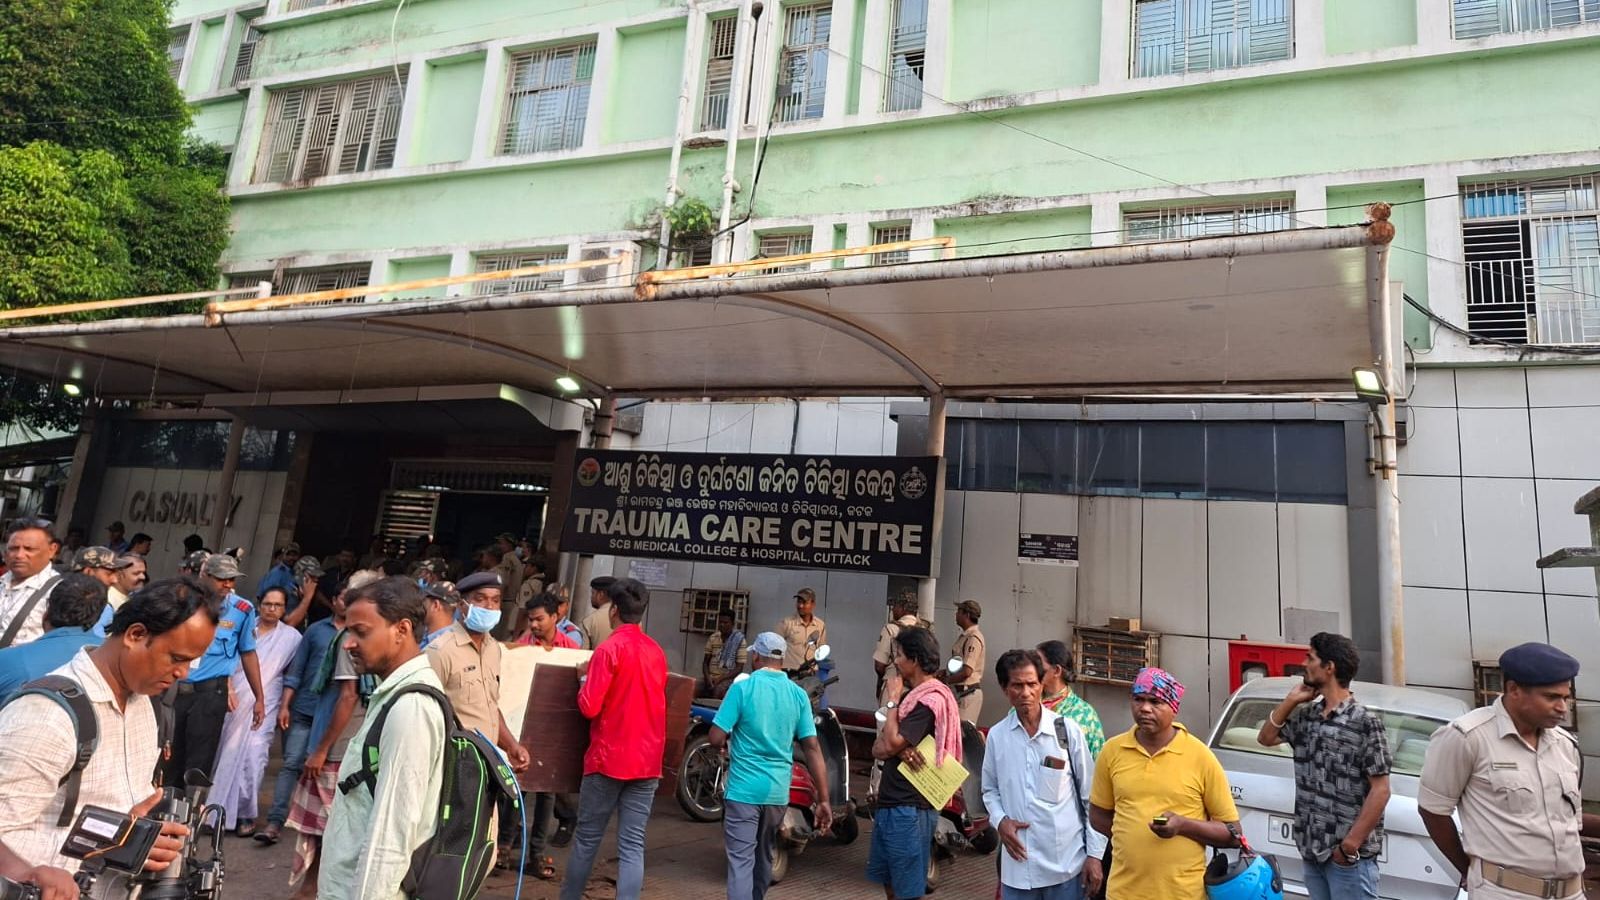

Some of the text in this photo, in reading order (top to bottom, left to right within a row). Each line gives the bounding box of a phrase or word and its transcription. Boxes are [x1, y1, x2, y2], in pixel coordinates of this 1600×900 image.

[128, 490, 242, 527] CASUALY
[574, 507, 923, 554] TRAUMA CARE CENTRE
[609, 538, 871, 566] SCB MEDICAL COLLEGE & HOSPITAL, CUTTACK
